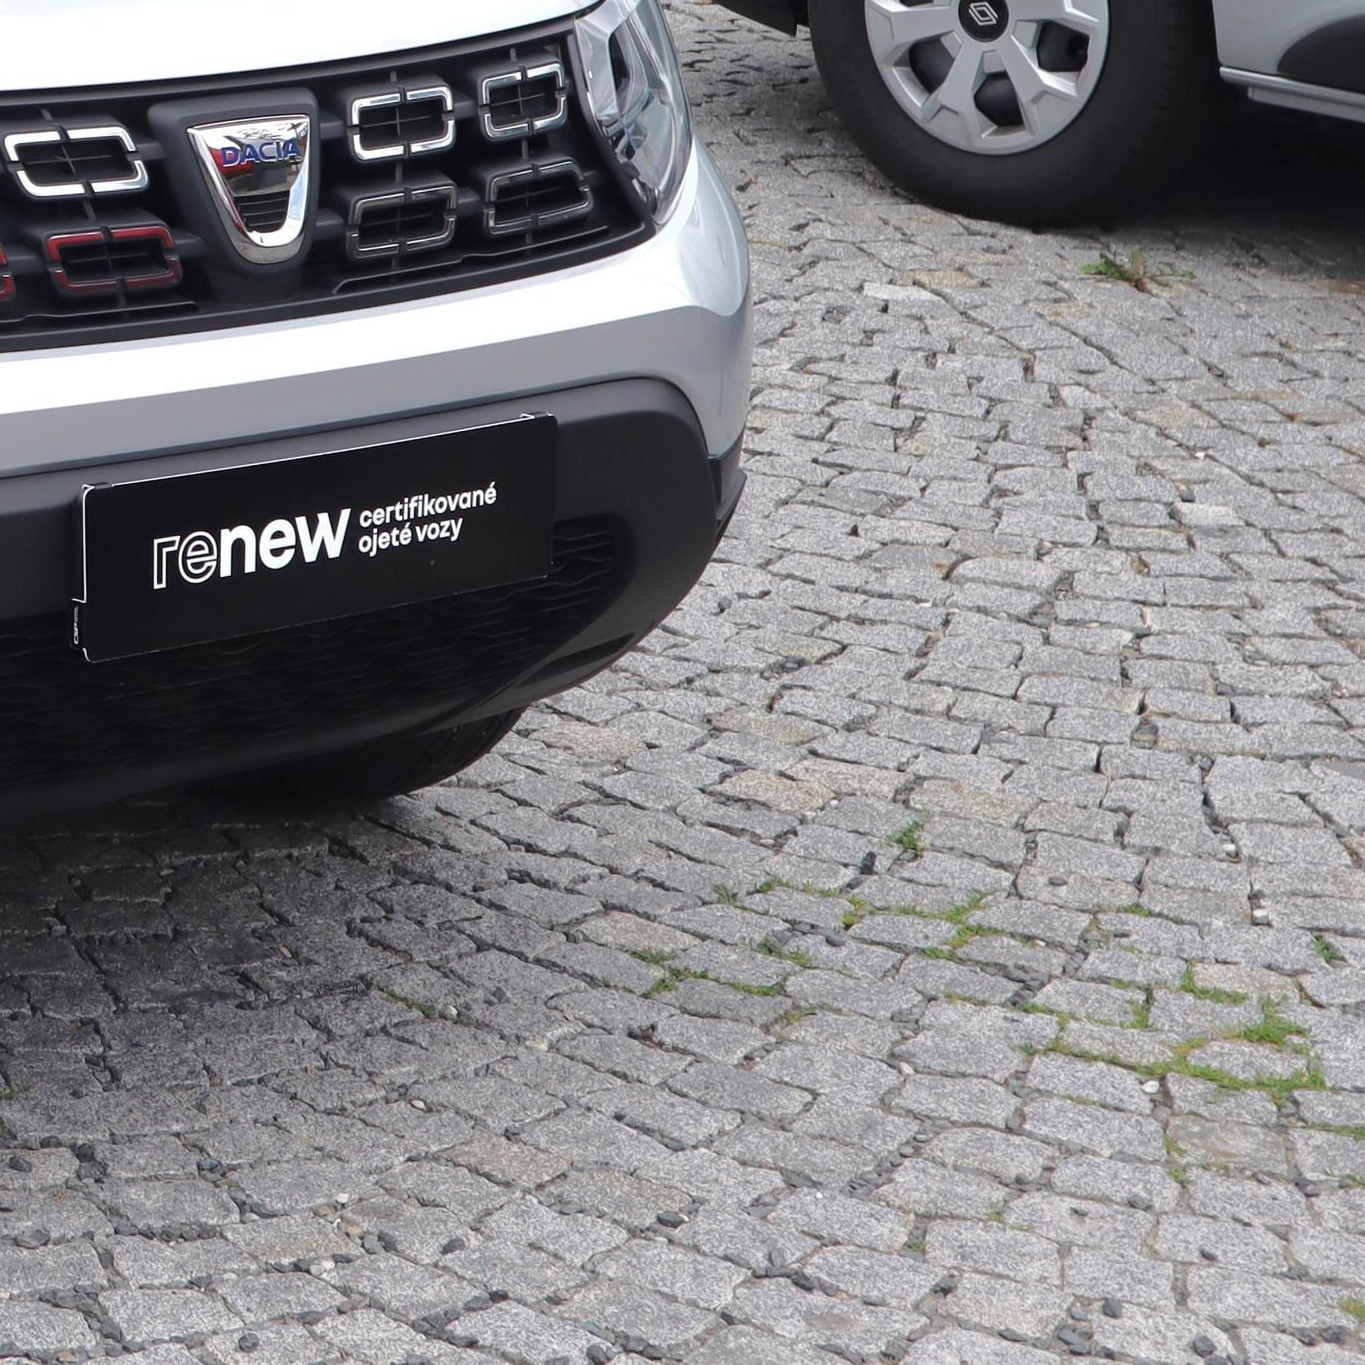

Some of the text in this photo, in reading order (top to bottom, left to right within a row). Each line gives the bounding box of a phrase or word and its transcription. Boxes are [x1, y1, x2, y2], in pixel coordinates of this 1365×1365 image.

[220, 137, 302, 167] DACIA
[153, 481, 497, 589] renew certifikované
[358, 518, 463, 557] ojeté vozy
